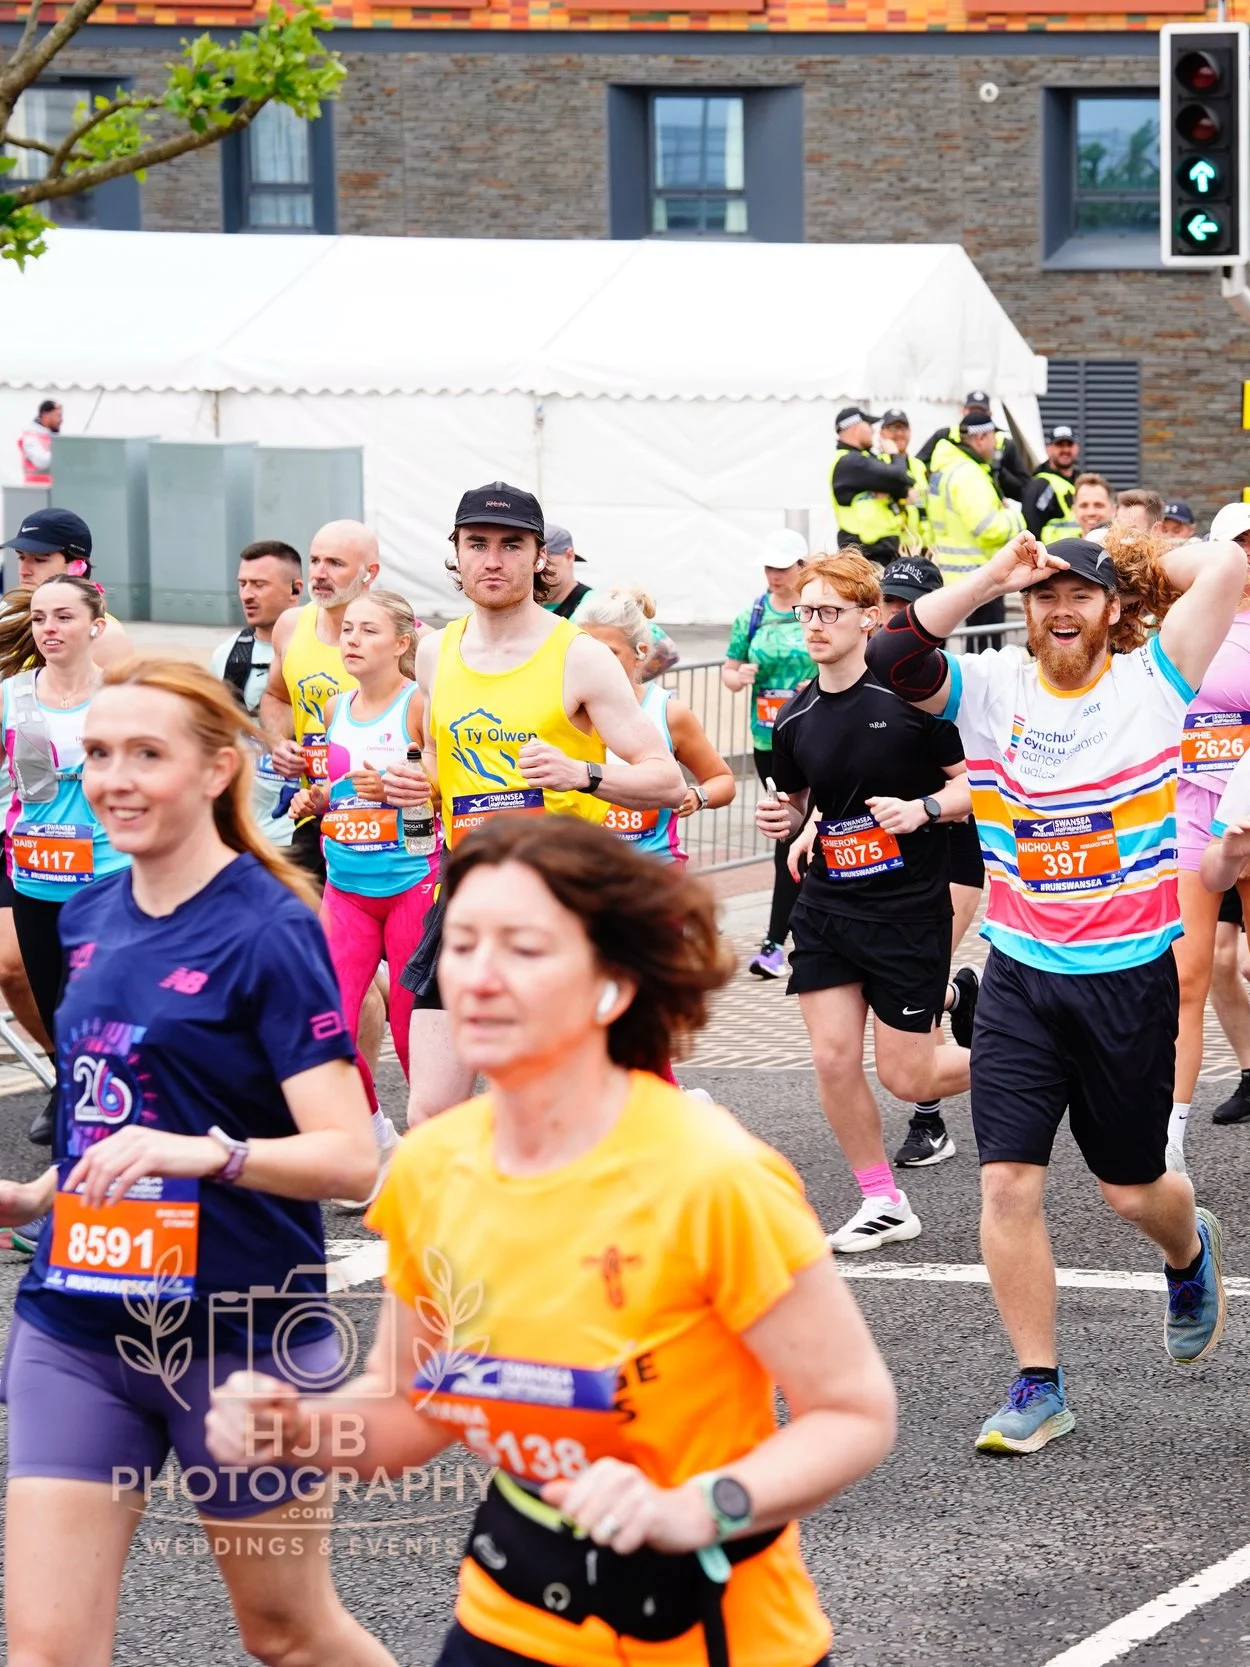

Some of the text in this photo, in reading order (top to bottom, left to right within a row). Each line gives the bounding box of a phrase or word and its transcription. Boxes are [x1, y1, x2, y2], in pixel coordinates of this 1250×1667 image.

[1195, 738, 1244, 759] 2626
[490, 792, 525, 802] SWANSEA
[323, 813, 349, 823] CERYS
[603, 810, 643, 829] 338
[842, 815, 872, 828] SWANSEA
[1054, 816, 1091, 828] SWANSEA
[335, 821, 381, 840] 2329
[13, 838, 38, 848] DAISY
[1017, 841, 1070, 853] NICHOLAS
[28, 849, 75, 870] 4117
[834, 841, 883, 867] 6075
[1042, 851, 1088, 877] 397
[1040, 878, 1102, 891] #RUNSWANSEA
[67, 1222, 154, 1269] 8591
